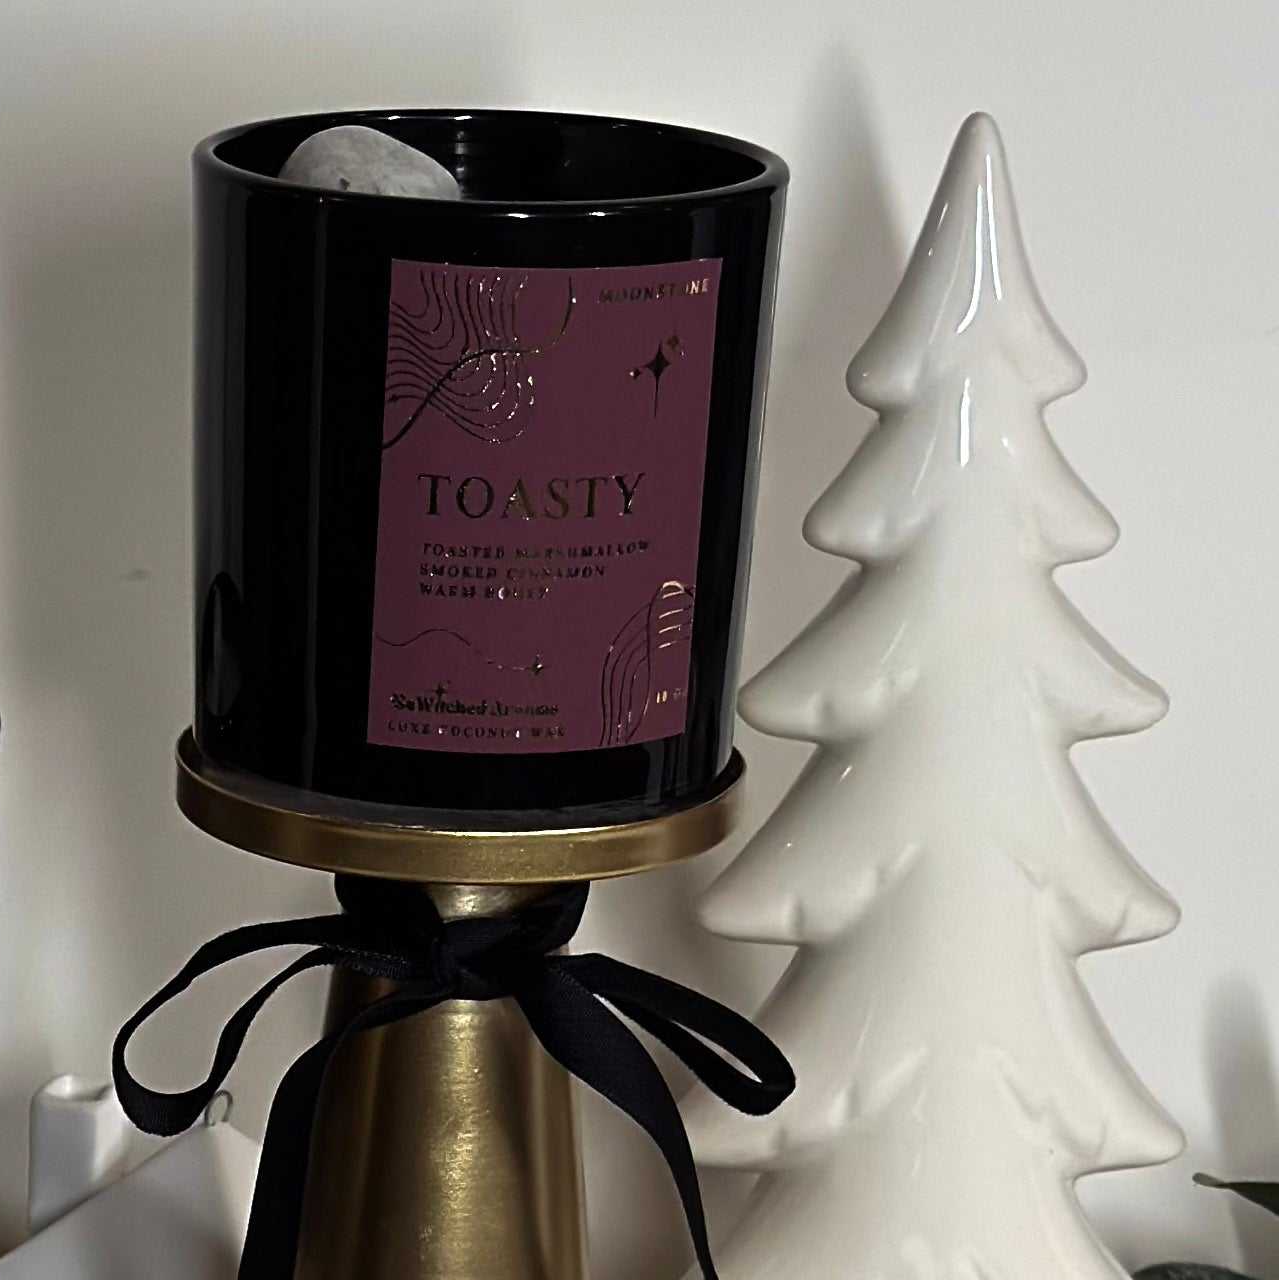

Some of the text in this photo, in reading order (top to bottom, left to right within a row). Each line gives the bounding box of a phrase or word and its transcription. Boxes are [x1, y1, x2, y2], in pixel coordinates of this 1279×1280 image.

[417, 471, 647, 520] TOASTY
[422, 542, 505, 560] TOASTED
[419, 563, 497, 579] SMOKED
[419, 582, 476, 599] WARM
[388, 719, 430, 735] LUXE
